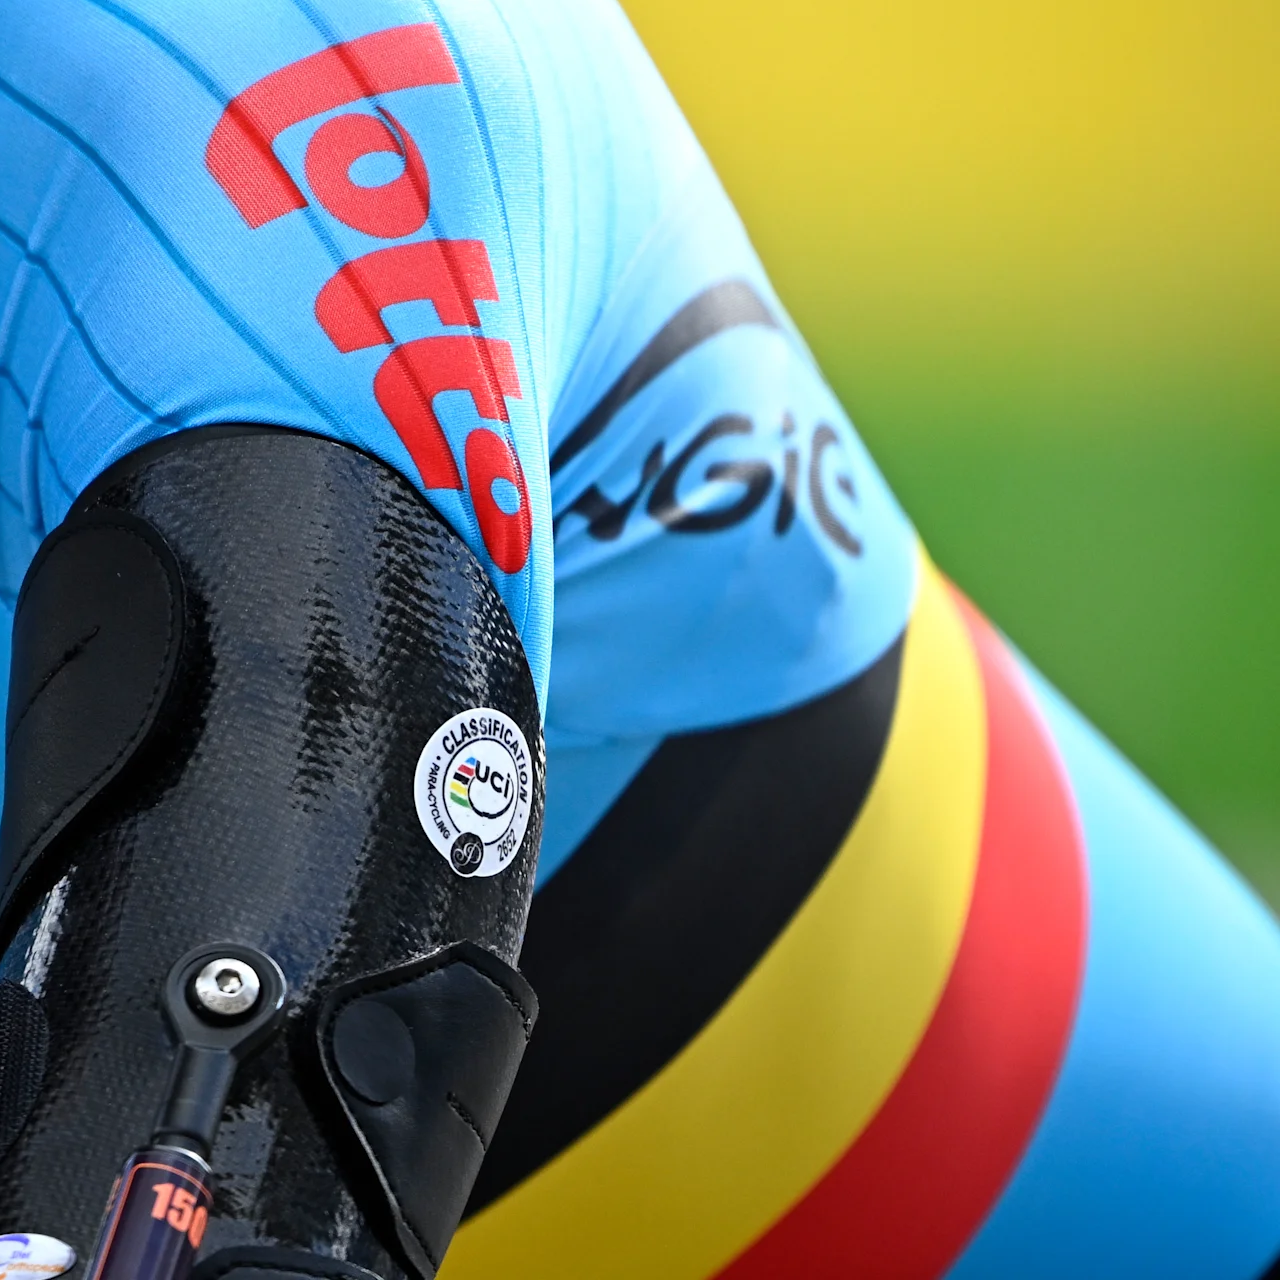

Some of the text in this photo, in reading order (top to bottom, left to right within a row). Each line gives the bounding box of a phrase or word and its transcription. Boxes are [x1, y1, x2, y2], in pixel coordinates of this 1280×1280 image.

[204, 22, 533, 573] Lotto
[427, 762, 451, 840] PARA-CYCLING
[497, 828, 517, 862] 2652
